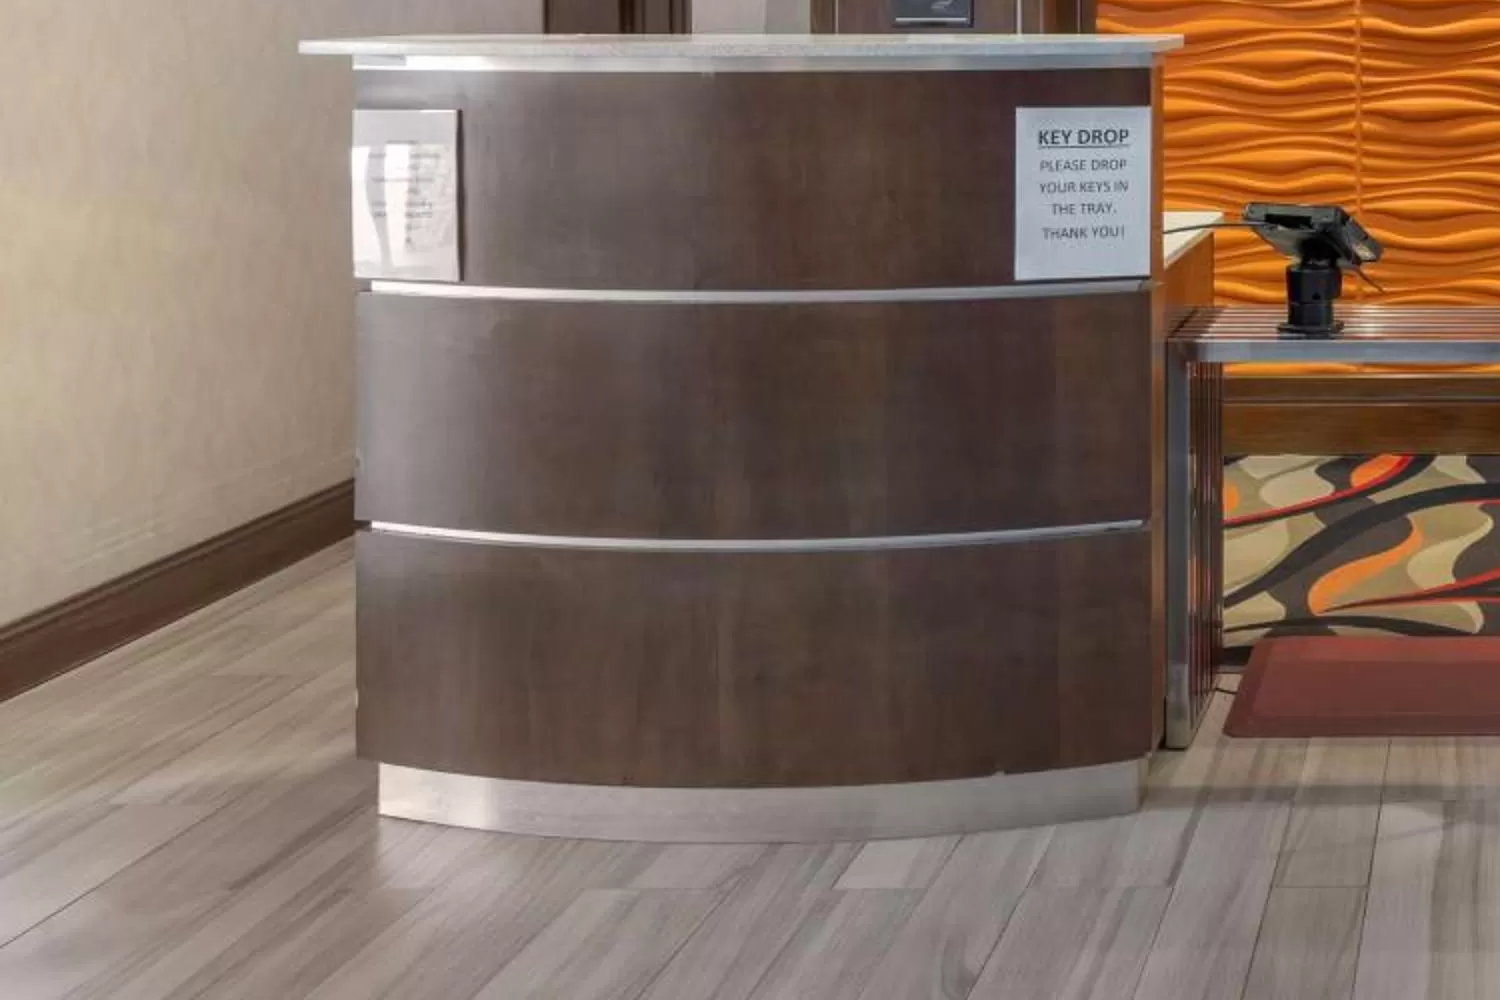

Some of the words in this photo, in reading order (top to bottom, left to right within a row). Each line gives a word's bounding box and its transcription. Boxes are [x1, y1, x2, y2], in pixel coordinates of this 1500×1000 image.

[1038, 129, 1073, 146] KEY
[1077, 128, 1130, 146] DROP
[1039, 159, 1087, 173] PLEASE
[1091, 159, 1127, 171] DROP
[1039, 181, 1077, 194] YOUR
[1079, 181, 1112, 193] KEYS
[1113, 180, 1129, 193] IN
[1051, 203, 1077, 216] THE
[1080, 202, 1118, 216] TRAY.
[1041, 227, 1089, 240] THANK
[1091, 225, 1126, 240] YOU!
